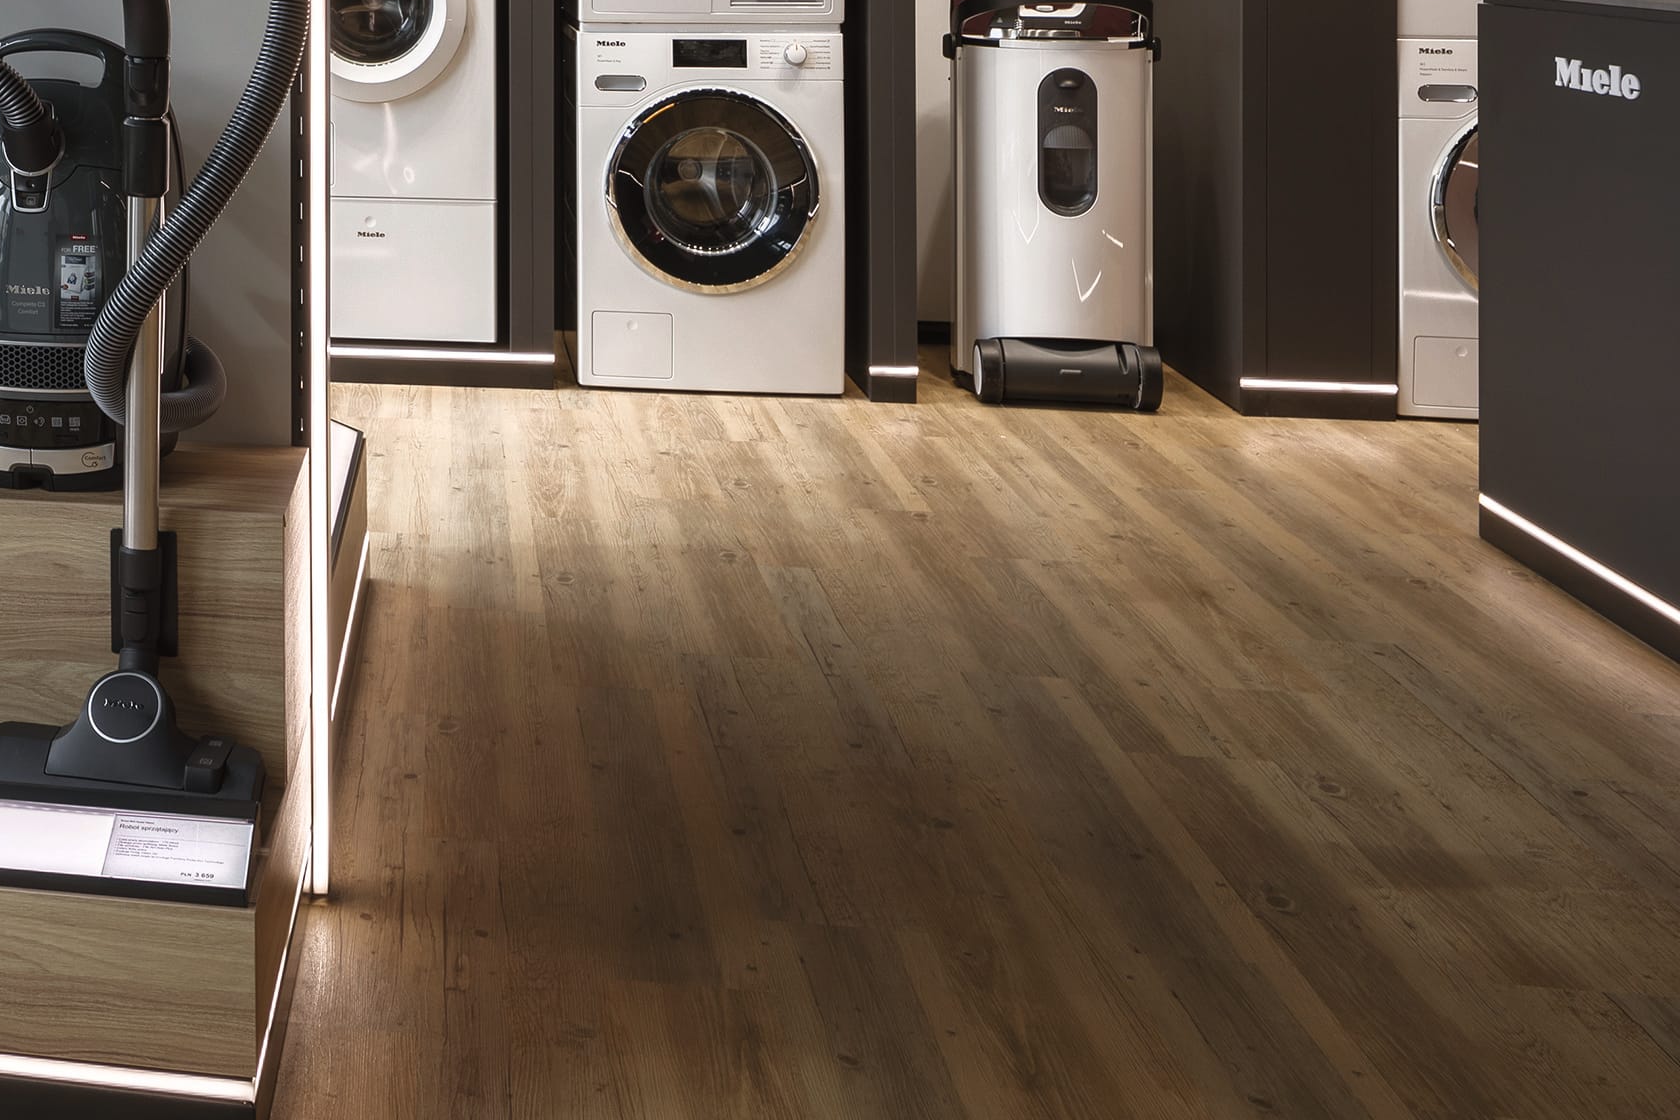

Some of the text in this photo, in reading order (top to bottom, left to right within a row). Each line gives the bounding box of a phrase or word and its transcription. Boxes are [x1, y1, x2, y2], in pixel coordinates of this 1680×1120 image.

[1418, 47, 1453, 55] Miele
[1554, 56, 1641, 101] Miele
[6, 284, 50, 295] Miele
